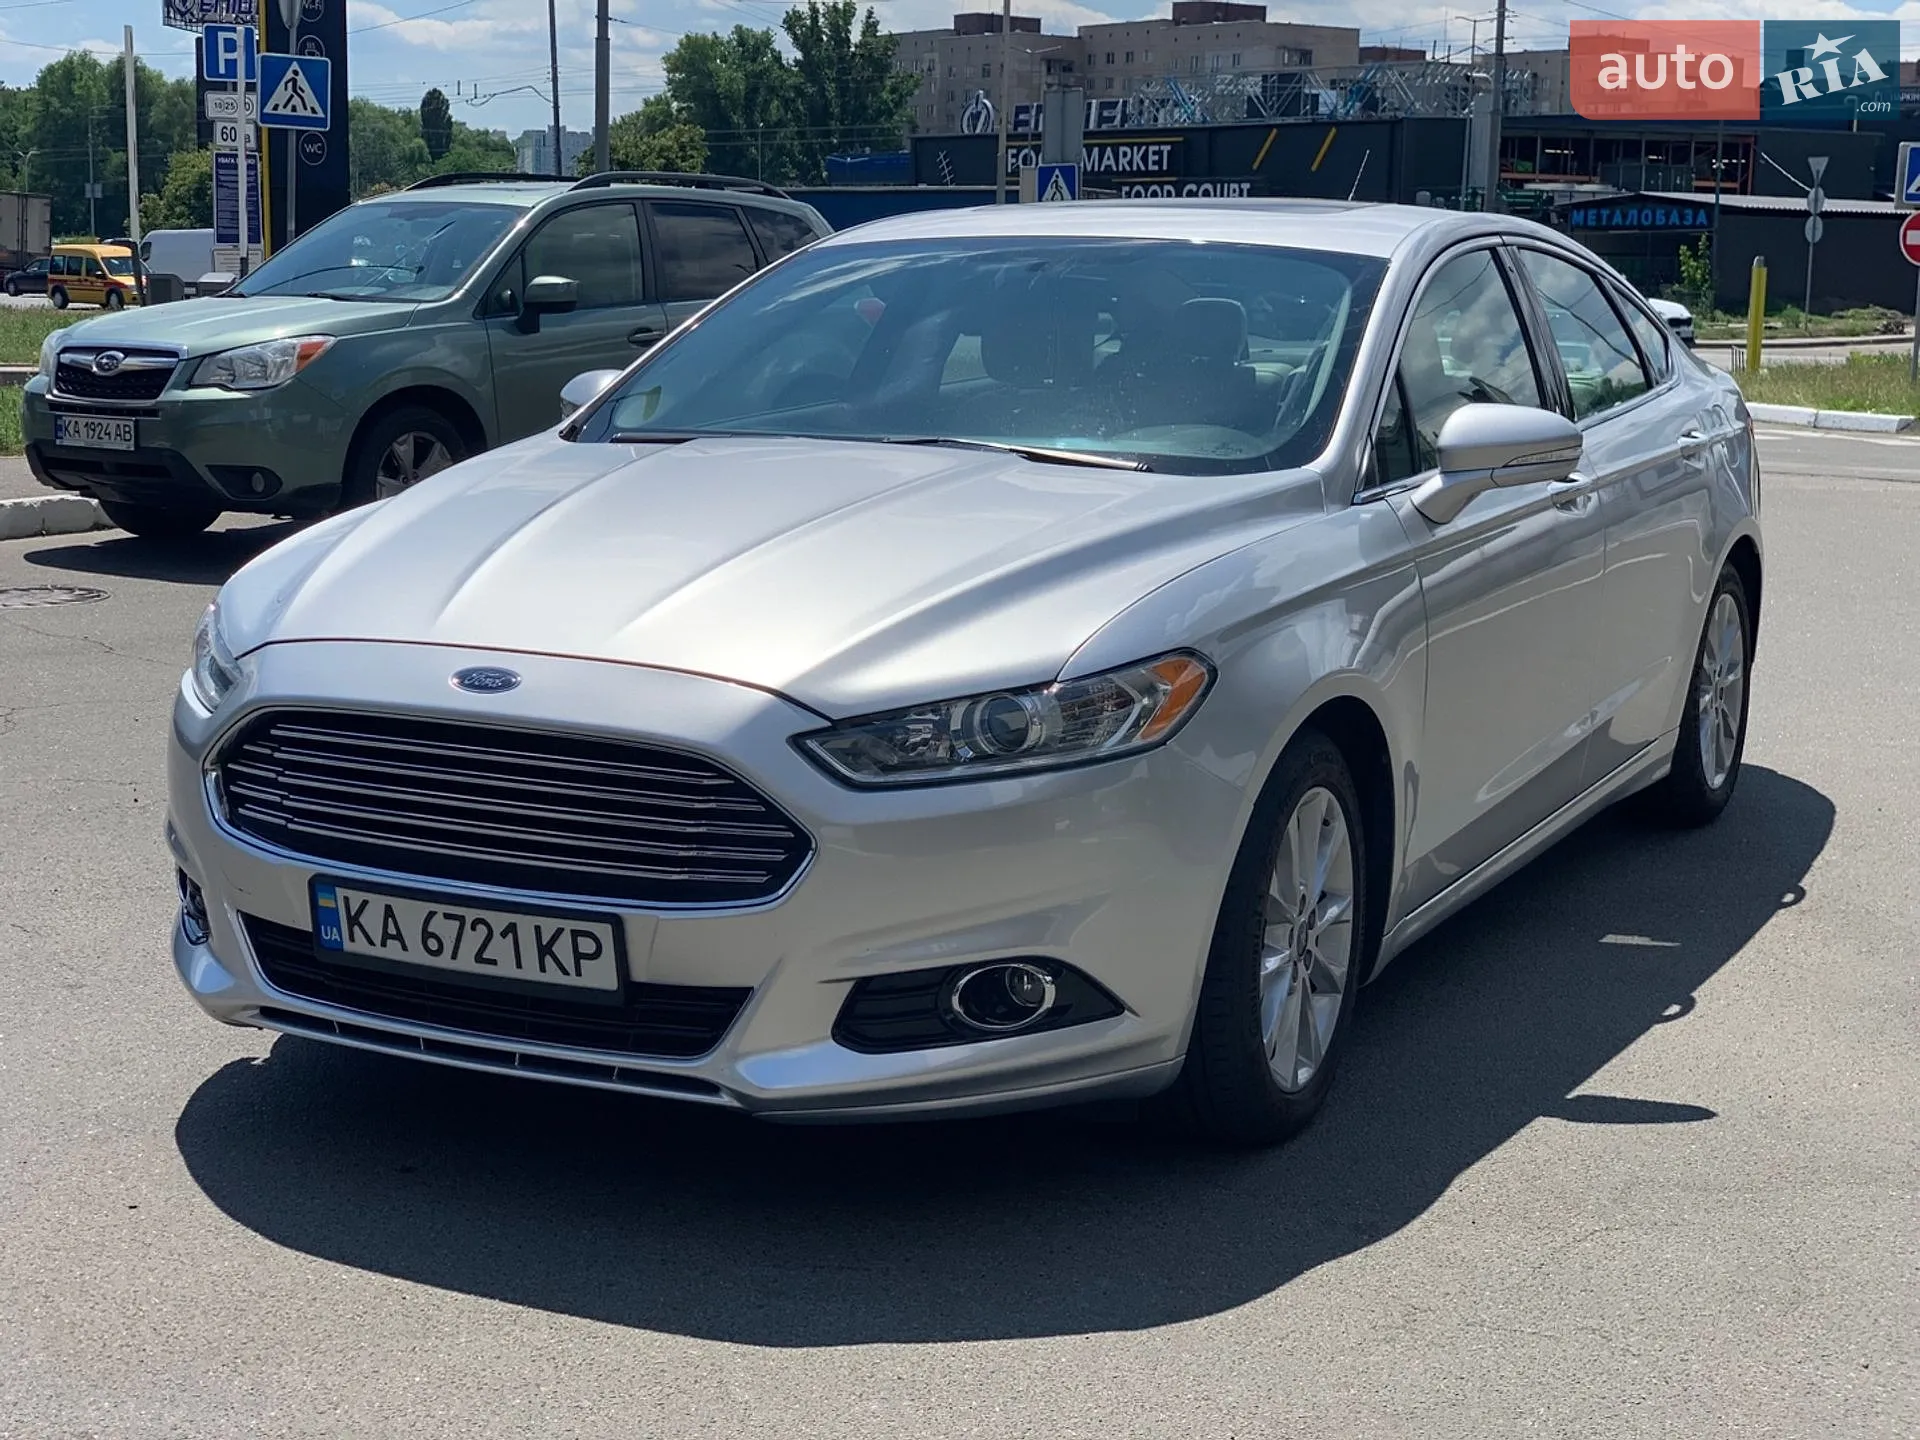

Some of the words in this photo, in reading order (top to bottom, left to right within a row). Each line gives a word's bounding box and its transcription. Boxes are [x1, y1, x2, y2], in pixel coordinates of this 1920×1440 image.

[221, 126, 237, 142] 60
[304, 143, 322, 154] WC
[1083, 145, 1172, 172] MARKET
[1571, 208, 1708, 228] МЕТАЛОБАЗА
[63, 419, 81, 438] KA
[84, 421, 112, 440] 1924
[114, 423, 133, 442] AB
[321, 925, 341, 942] UA
[343, 895, 409, 952] KA
[421, 910, 524, 970] 6721
[533, 924, 604, 978] KP
